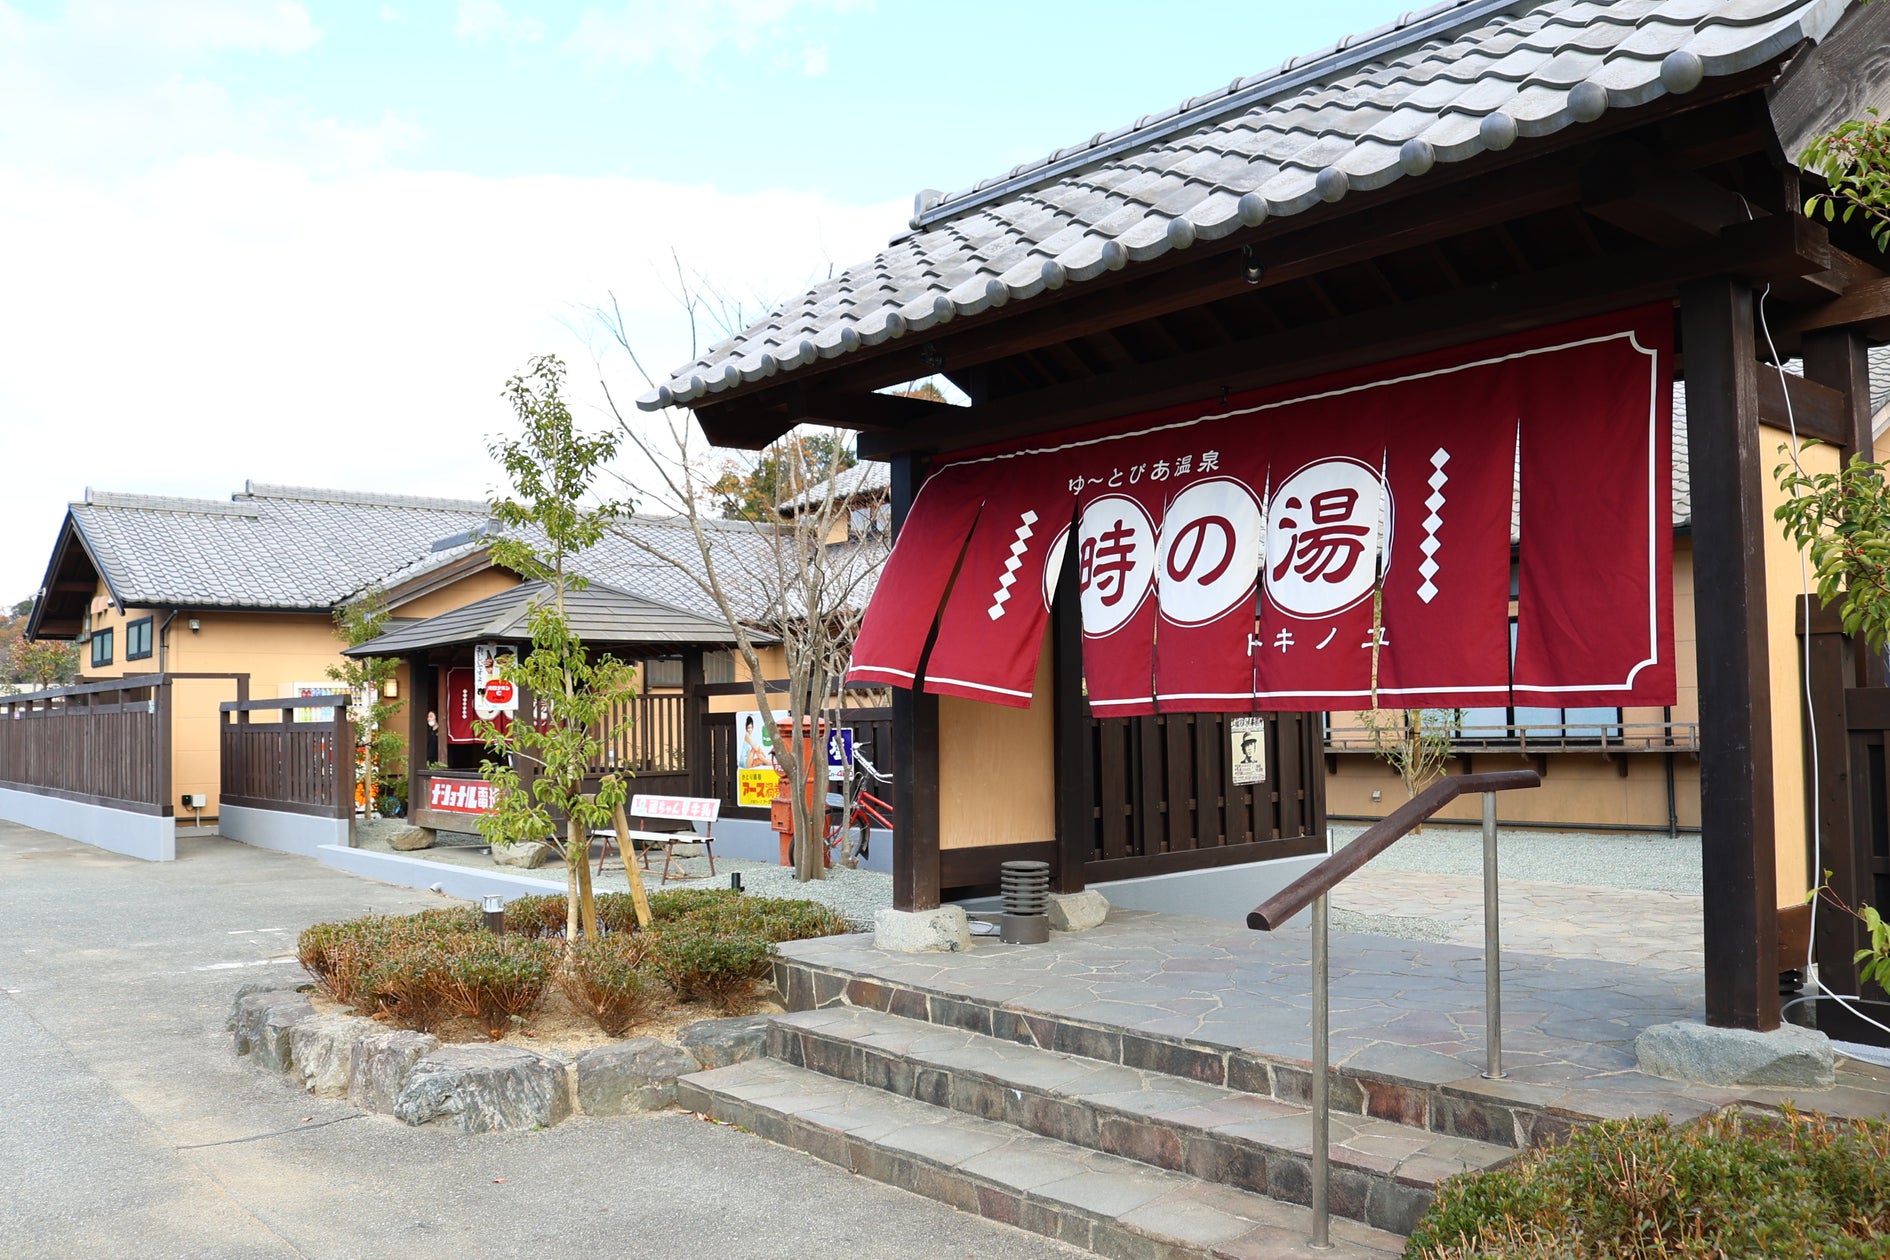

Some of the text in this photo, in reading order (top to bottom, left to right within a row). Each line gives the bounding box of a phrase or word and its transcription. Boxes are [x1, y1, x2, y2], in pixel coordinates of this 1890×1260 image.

[1080, 487, 1371, 607] 時の湯
[1246, 626, 1391, 657] トキノユ
